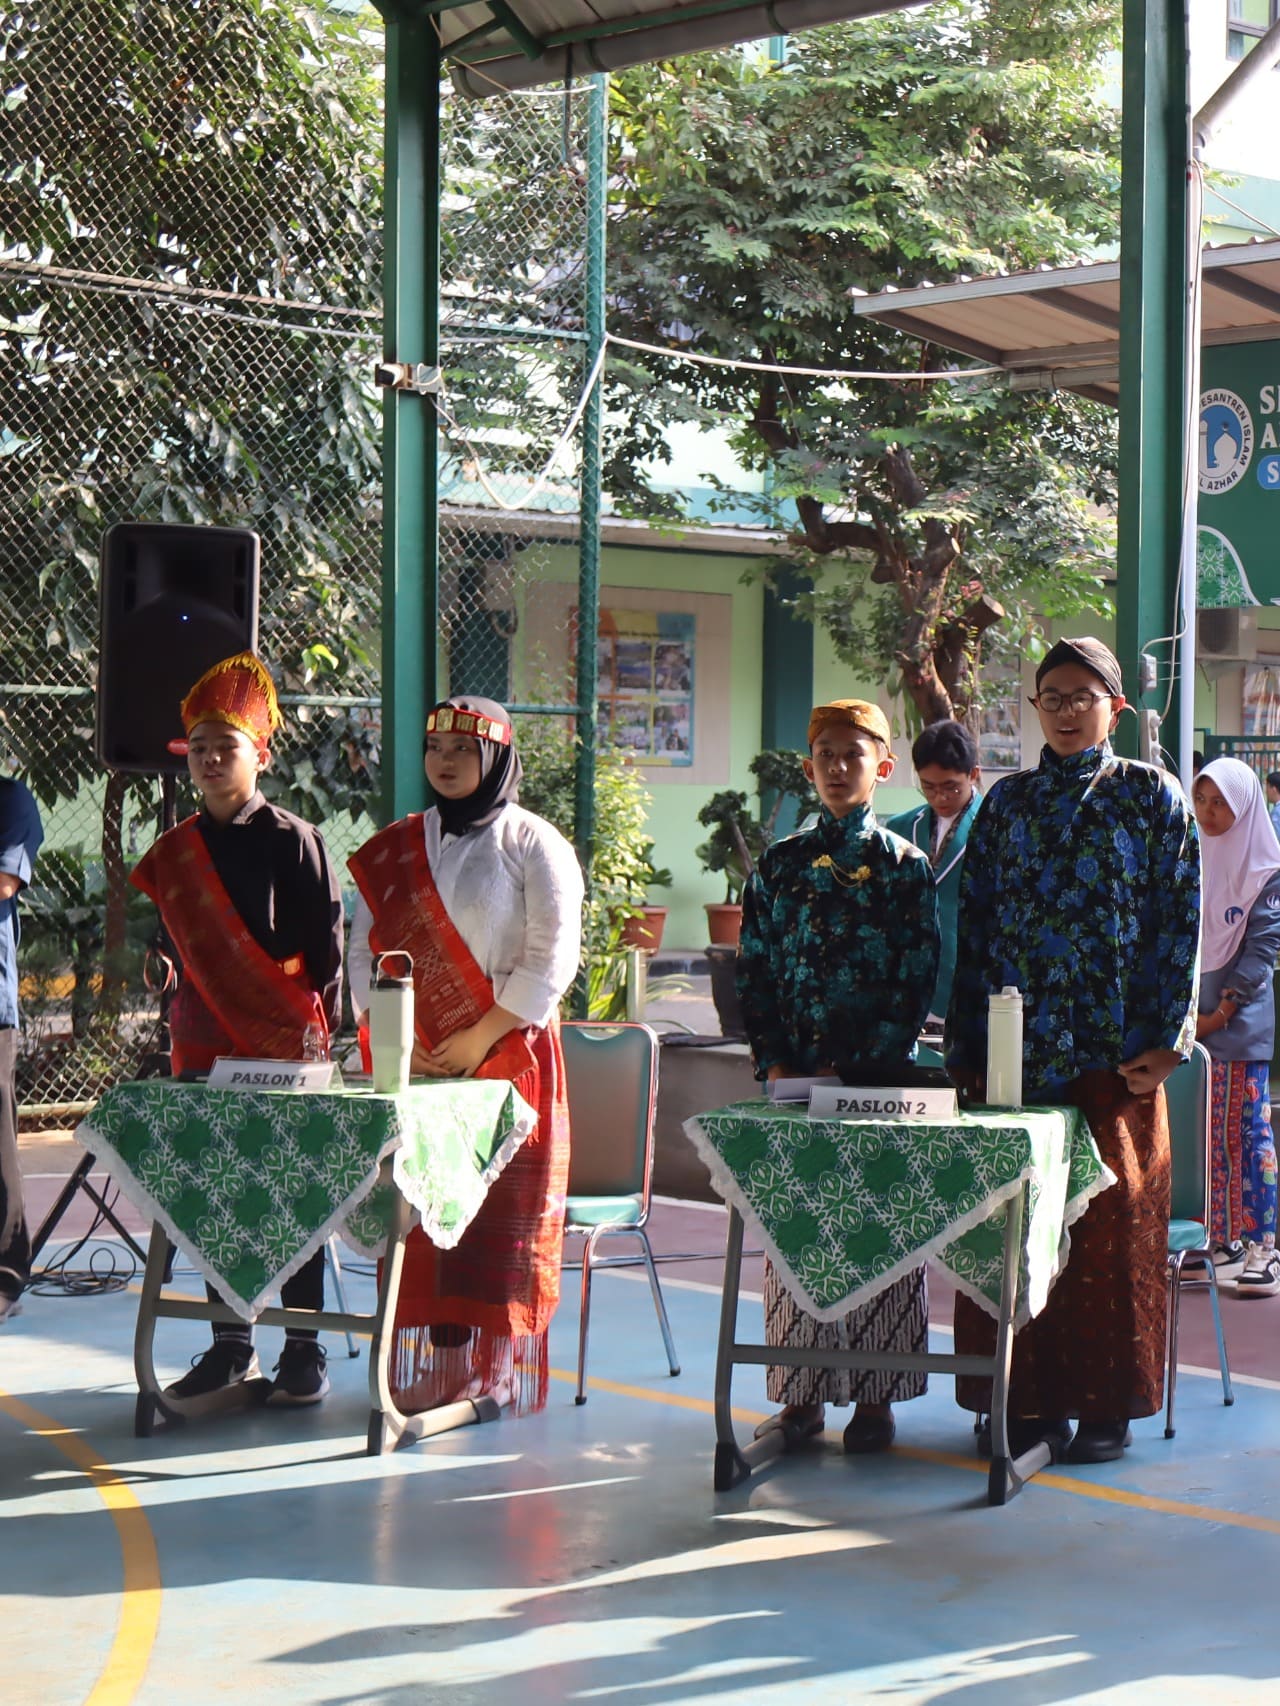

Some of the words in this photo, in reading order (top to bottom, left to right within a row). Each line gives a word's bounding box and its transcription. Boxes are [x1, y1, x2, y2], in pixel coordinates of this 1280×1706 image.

[1200, 393, 1247, 421] ESANTREN
[1240, 423, 1251, 466] ISLAM
[1206, 471, 1238, 491] AZHAR
[230, 1072, 296, 1087] PASLON
[298, 1075, 307, 1087] 1
[836, 1099, 912, 1114] PASLON
[916, 1102, 927, 1115] 2
